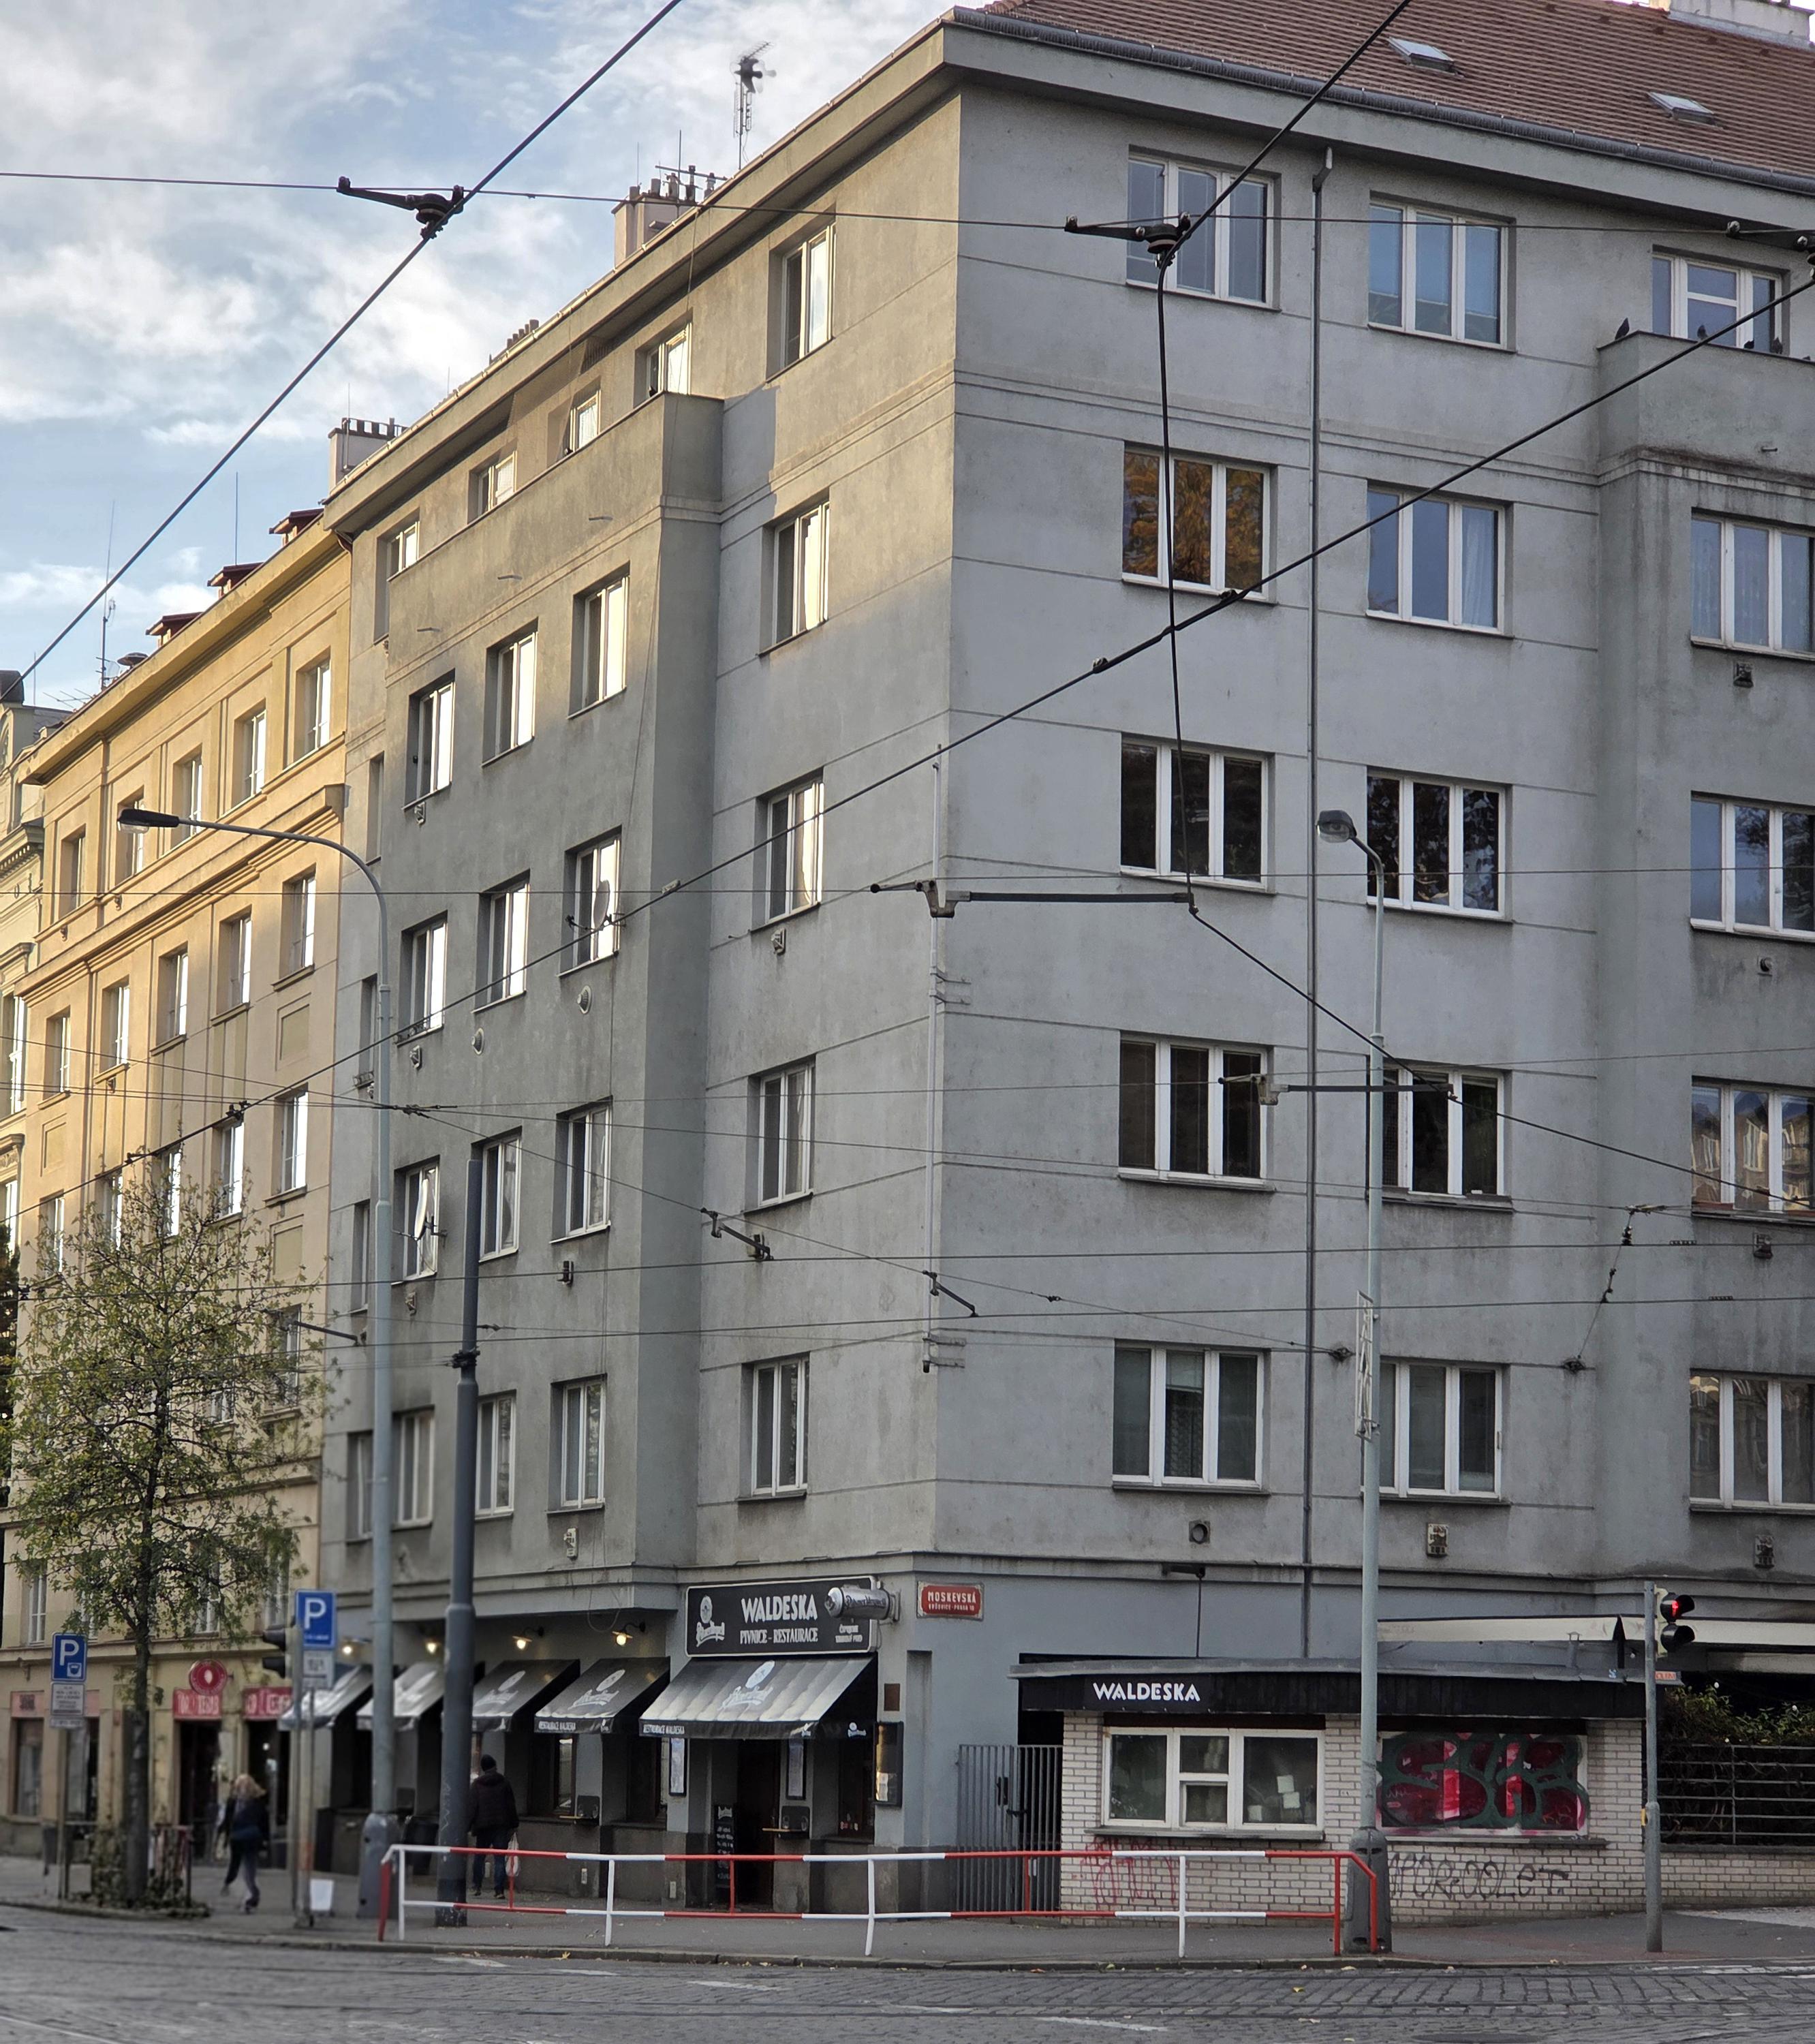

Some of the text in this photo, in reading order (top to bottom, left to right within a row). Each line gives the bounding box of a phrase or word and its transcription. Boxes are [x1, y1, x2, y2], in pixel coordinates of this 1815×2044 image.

[741, 1594, 818, 1623] WALDESKA
[927, 1591, 976, 1604] MOSKEVSKÁ
[305, 1597, 326, 1629] P
[740, 1629, 768, 1644] PIVNICE
[773, 1627, 818, 1643] RESTAURACE
[59, 1639, 79, 1666] P
[1093, 1682, 1200, 1701] WALDESKA
